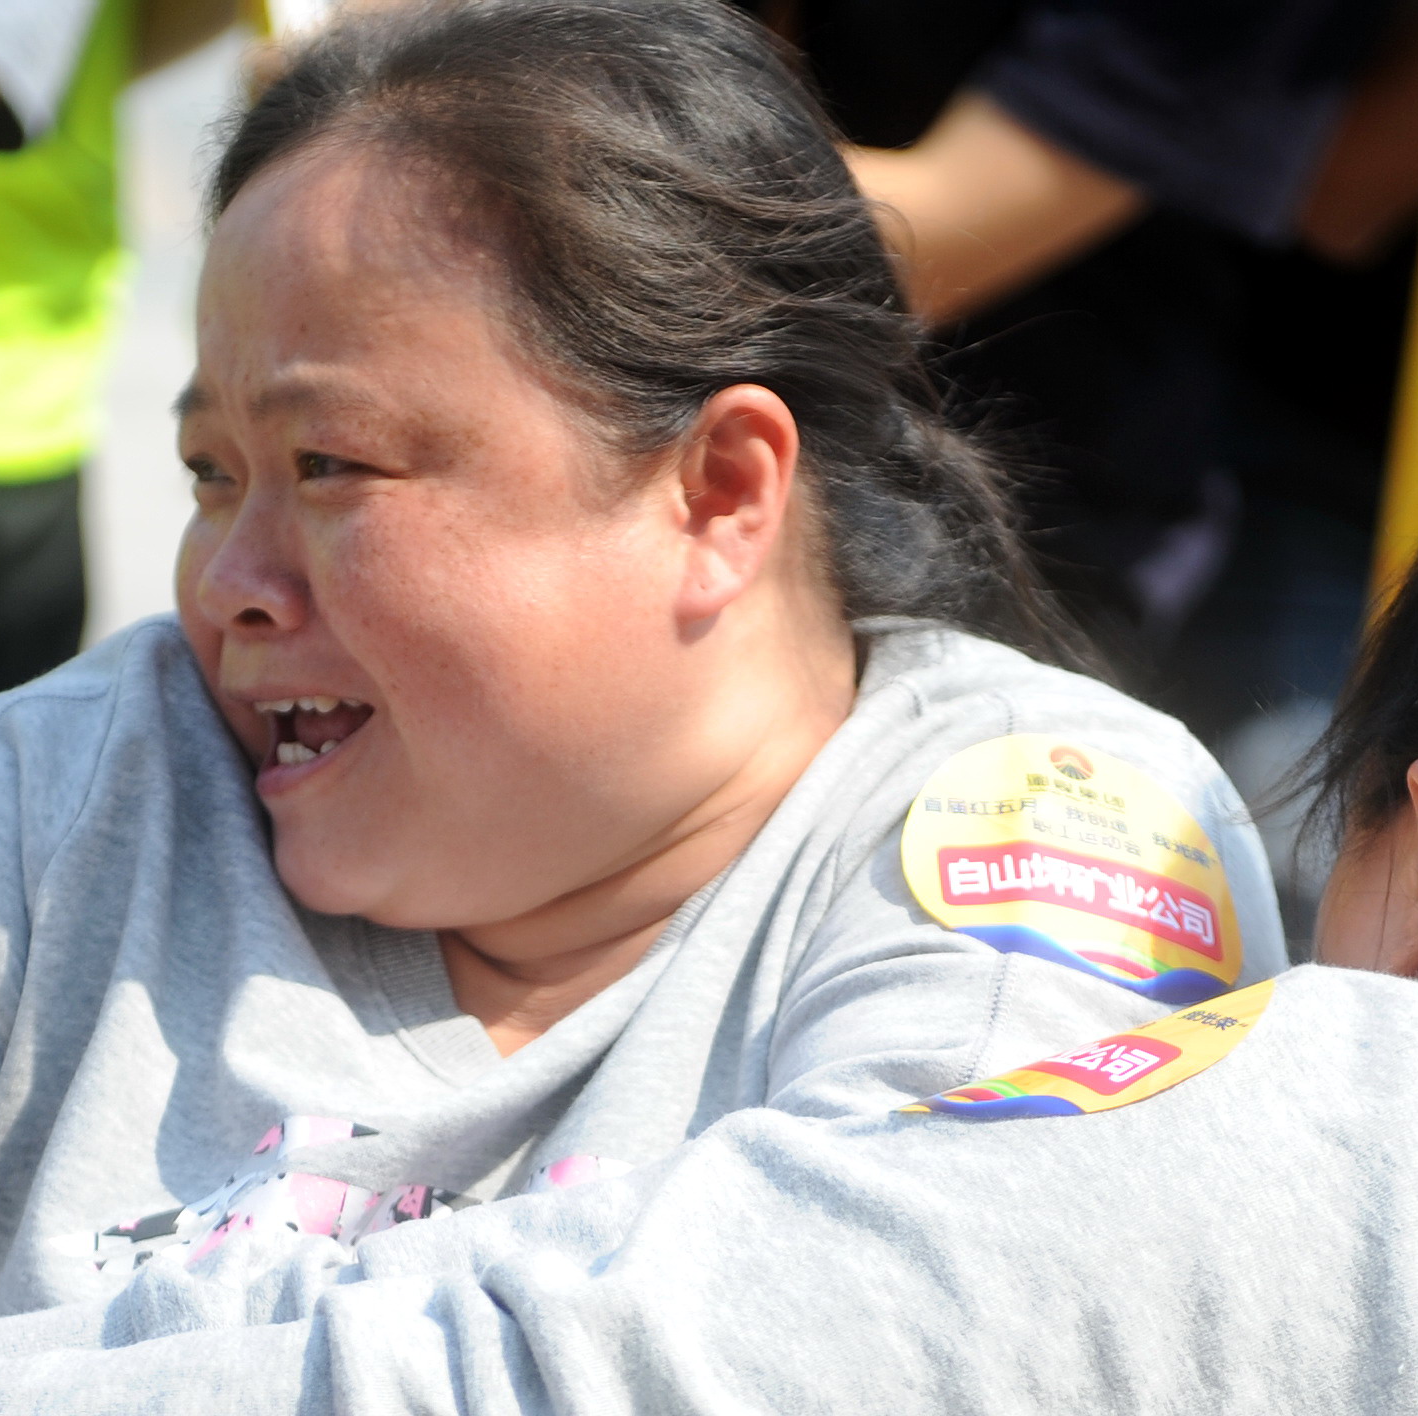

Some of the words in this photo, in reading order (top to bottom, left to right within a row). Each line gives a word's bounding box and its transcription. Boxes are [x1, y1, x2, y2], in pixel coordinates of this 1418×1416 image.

[947, 853, 1216, 946] 白山坪矿业公司
